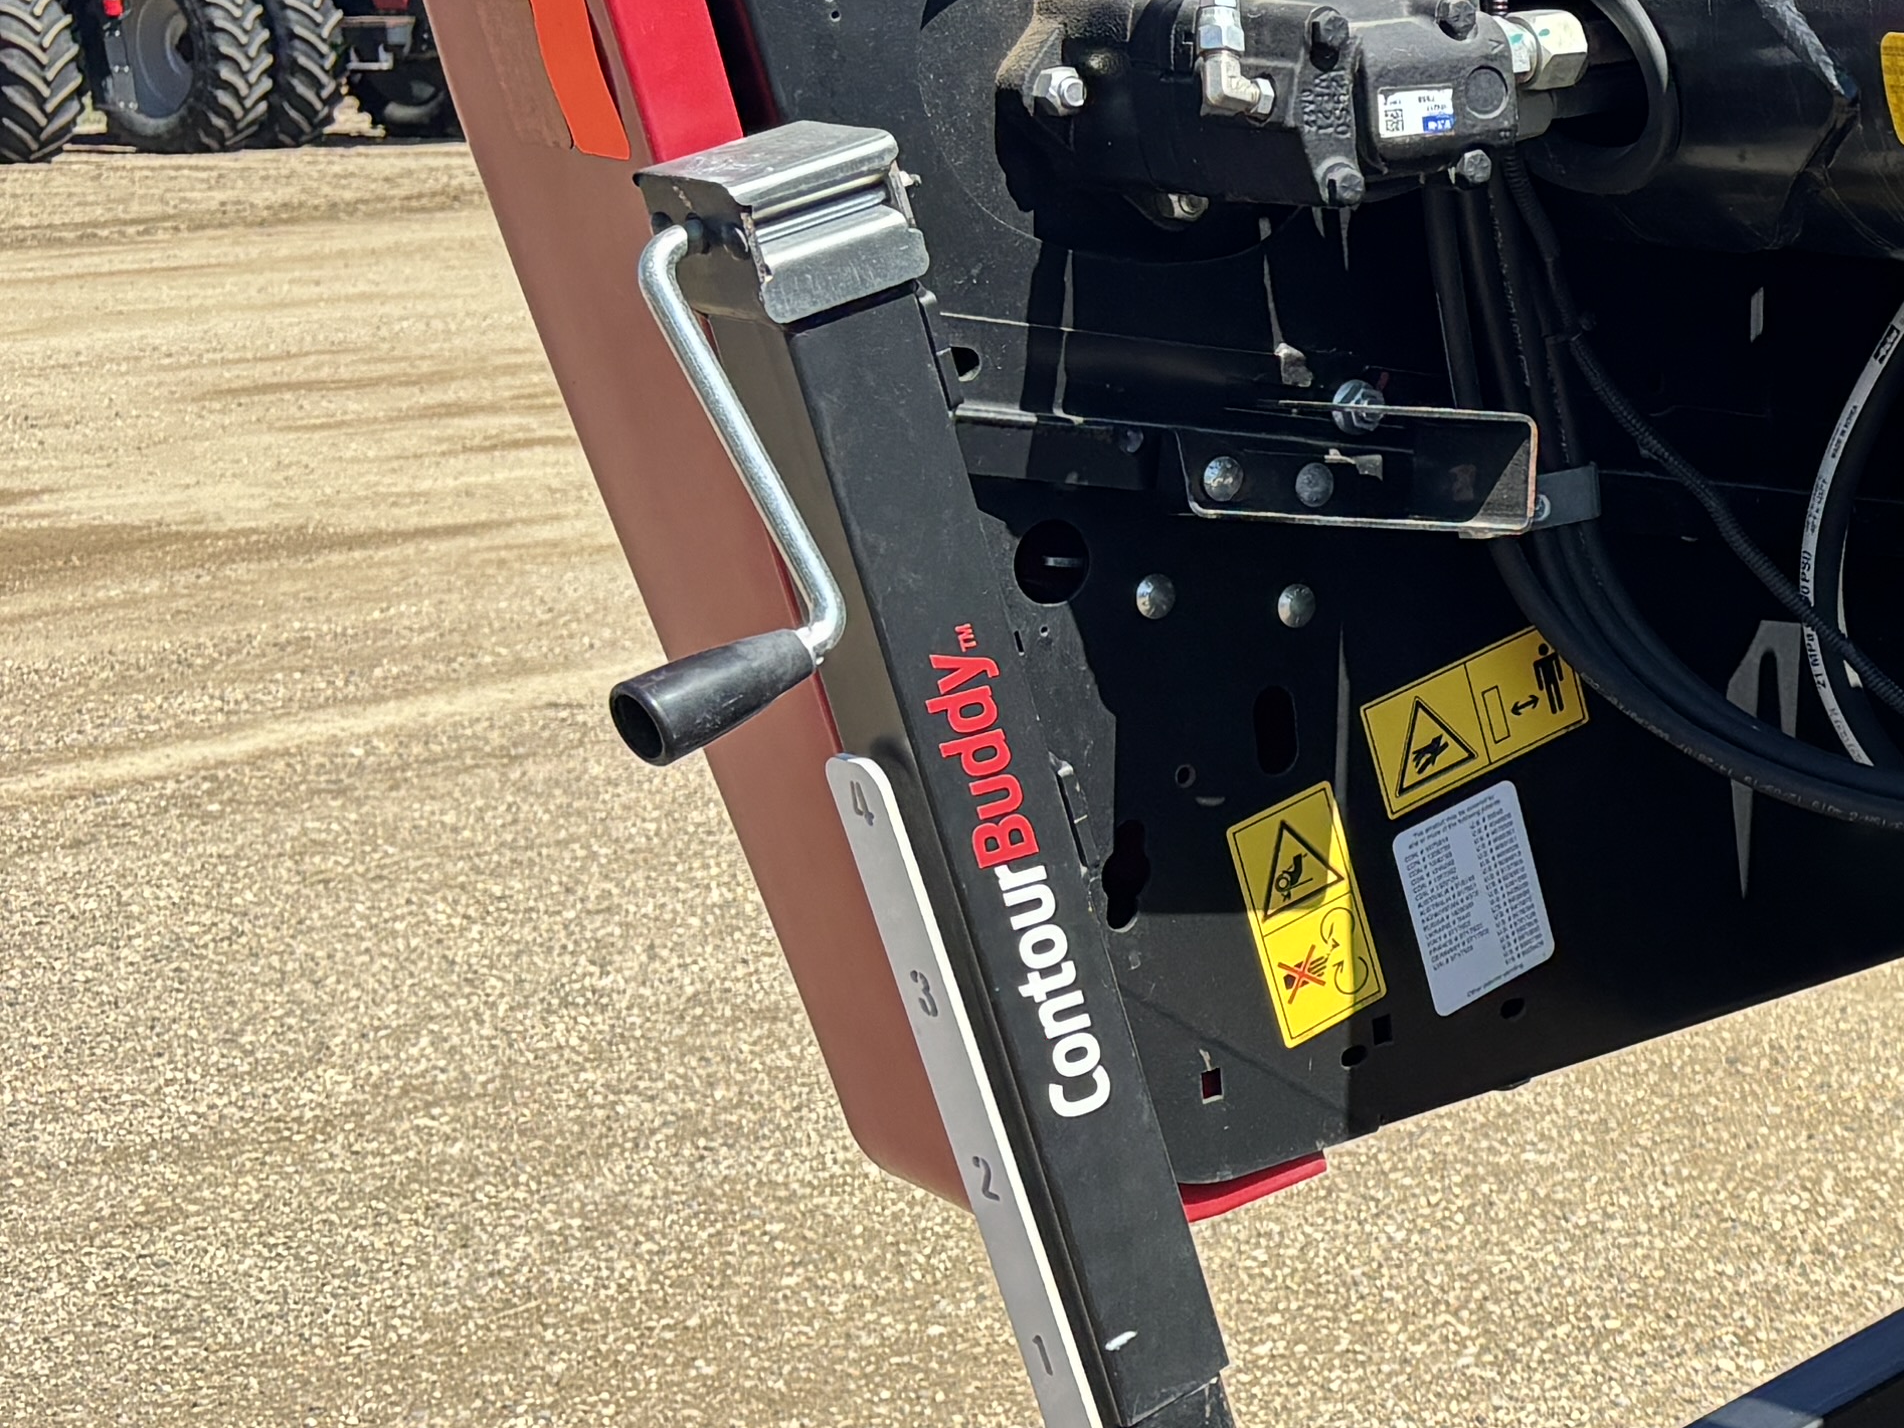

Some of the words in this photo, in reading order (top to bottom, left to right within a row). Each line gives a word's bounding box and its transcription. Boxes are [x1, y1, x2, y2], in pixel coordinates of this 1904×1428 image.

[853, 779, 873, 827] 4
[910, 970, 939, 1019] 3
[972, 1156, 999, 1204] 2
[1030, 1333, 1055, 1375] 1
